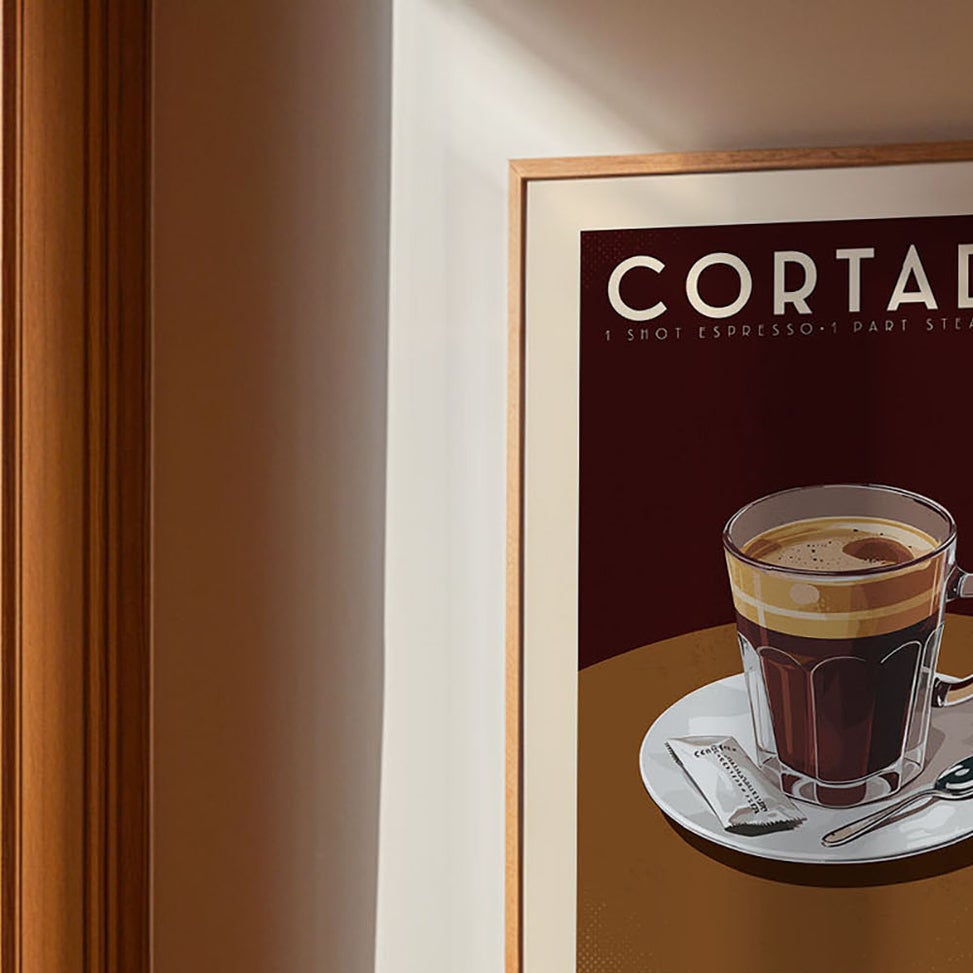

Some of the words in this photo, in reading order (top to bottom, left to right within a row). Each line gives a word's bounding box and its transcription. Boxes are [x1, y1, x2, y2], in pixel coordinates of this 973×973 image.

[604, 329, 611, 342] 1
[626, 326, 683, 342] SHOT
[853, 319, 908, 333] PART
